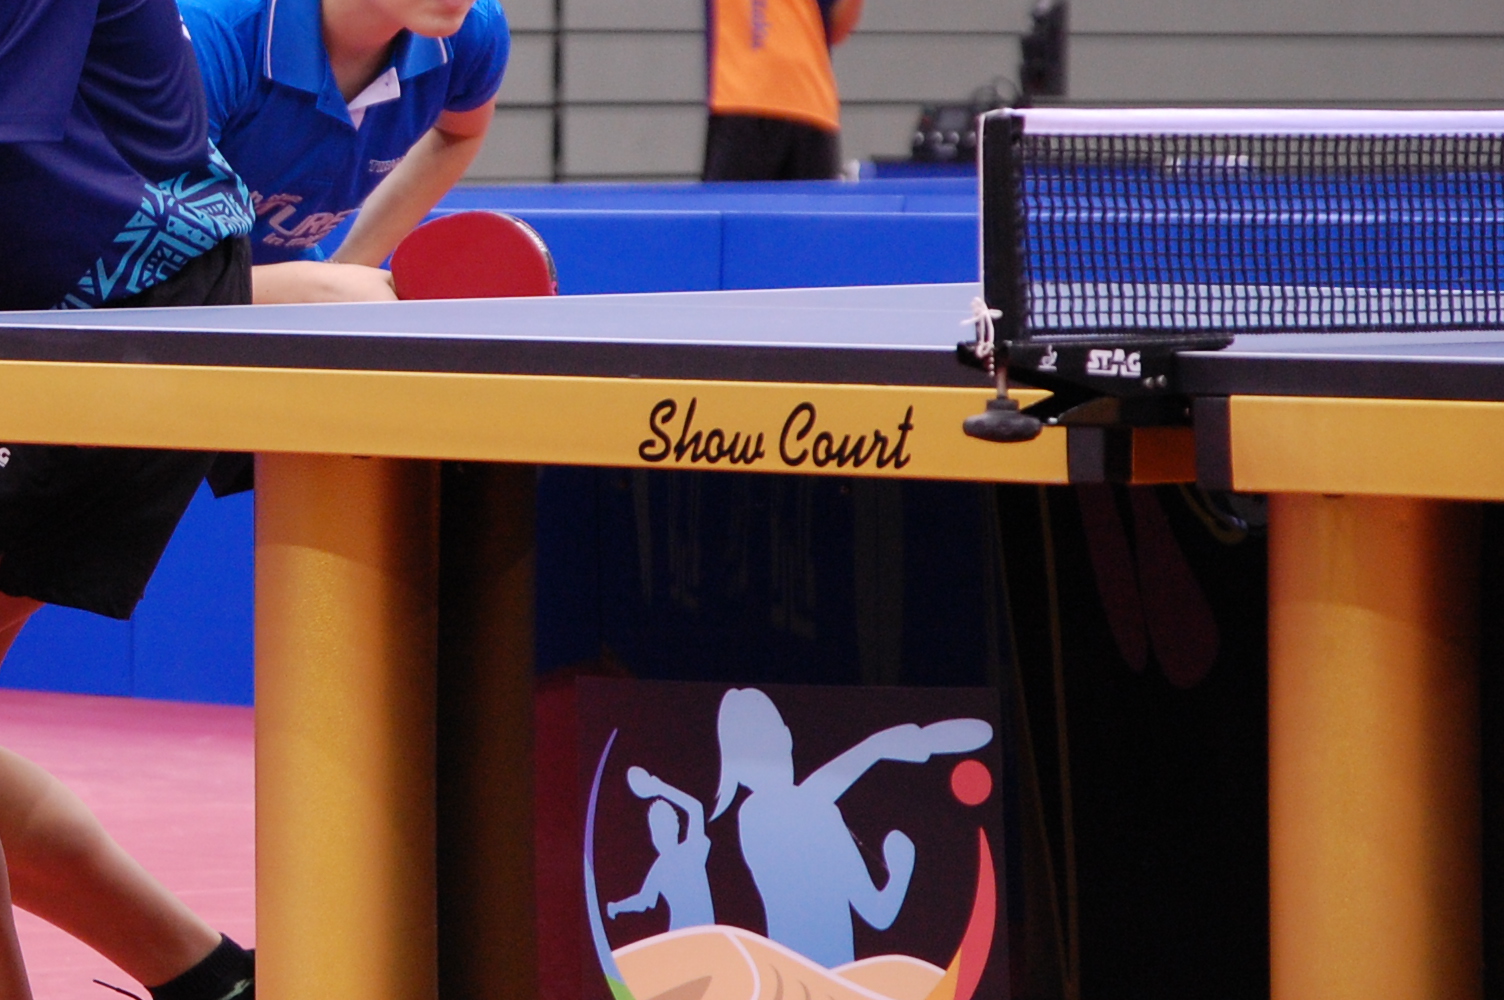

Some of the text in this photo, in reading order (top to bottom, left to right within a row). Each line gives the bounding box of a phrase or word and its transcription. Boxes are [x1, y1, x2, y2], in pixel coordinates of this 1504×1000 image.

[1087, 348, 1142, 377] STAG
[638, 397, 914, 469] Show Court
